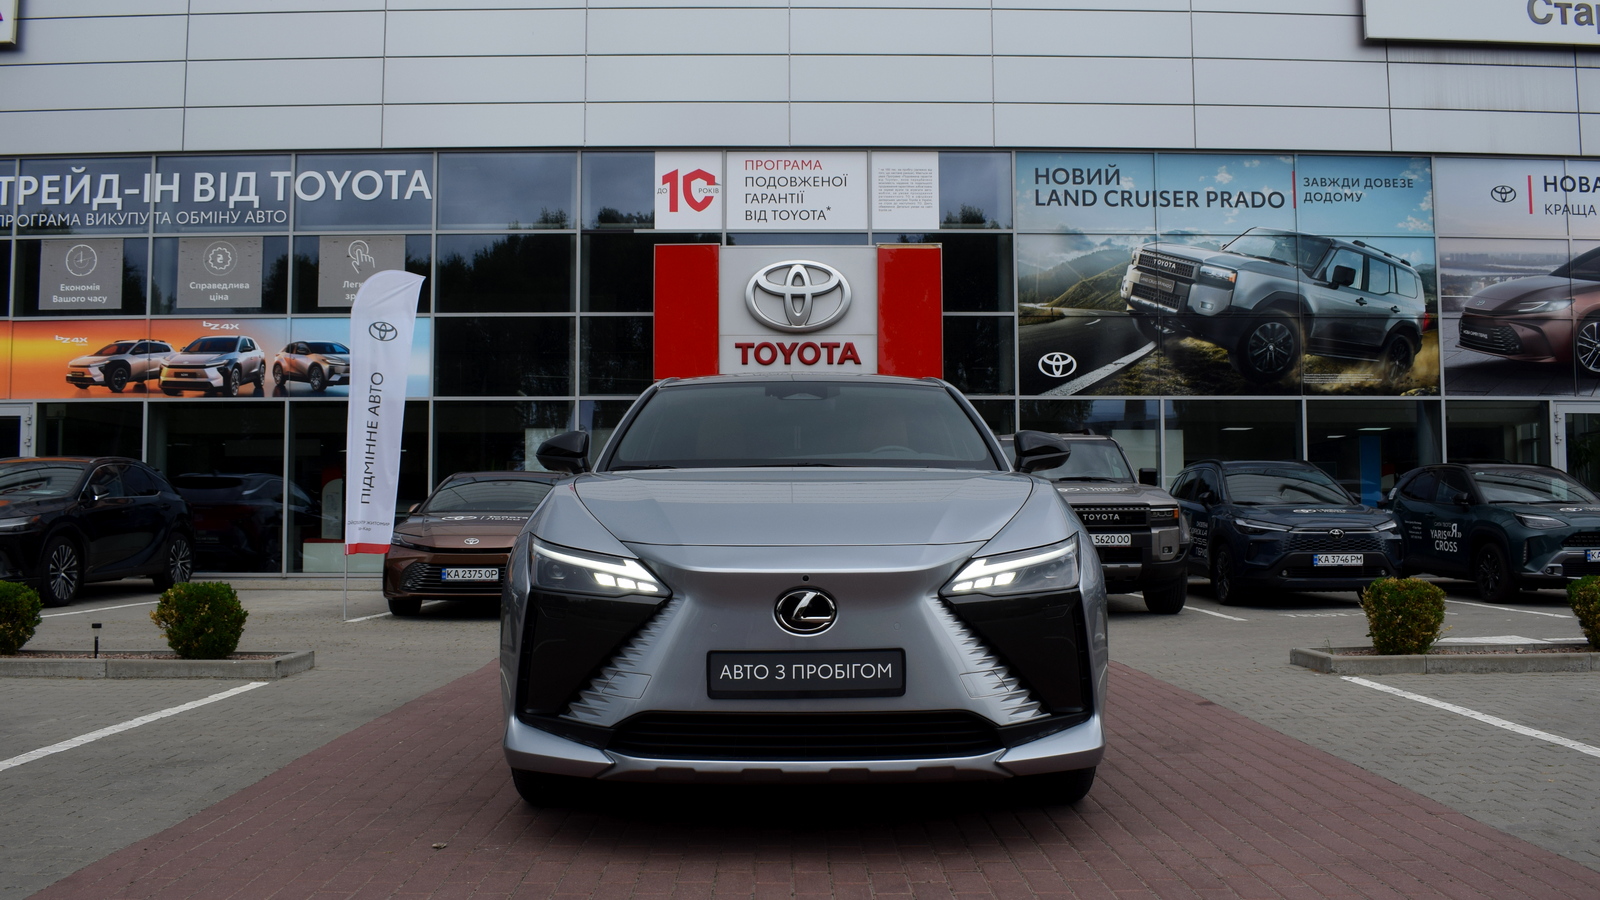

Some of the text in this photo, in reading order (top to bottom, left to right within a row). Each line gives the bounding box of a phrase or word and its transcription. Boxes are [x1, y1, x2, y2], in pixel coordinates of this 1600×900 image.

[1527, 0, 1600, 35] Ста
[744, 159, 823, 171] ПРОГРАМА
[744, 173, 848, 189] ПОДОВЖЕНОЇ
[1034, 163, 1121, 186] НОВИЙ
[0, 166, 433, 211] ТРЕЙД-ІН ВІД TOYOTA
[1303, 176, 1415, 191] ЗАВЖДИ ДОВЕЗЕ
[656, 187, 668, 195] ДО
[744, 190, 805, 204] ГАРАНТІЇ
[1303, 190, 1363, 204] ДОДОМУ
[1034, 189, 1285, 209] LAND CRUISER PRADO
[744, 210, 768, 223] ВІД
[1544, 203, 1597, 218] КРАЩА
[86, 212, 150, 227] ВИКУПУ
[154, 211, 172, 225] ТА
[176, 210, 241, 225] ОБМІНУ
[244, 209, 287, 224] АВТО
[60, 283, 101, 292] Економія
[189, 281, 250, 291] Справедлива
[52, 294, 107, 304] Вашого часу
[209, 292, 229, 302] ціна
[735, 342, 861, 365] TOYOTA
[360, 372, 384, 505] ПІДМІННЕ АВТО
[1082, 513, 1120, 521] TOYOTA
[1095, 535, 1116, 544] 5620
[1430, 529, 1447, 540] YARIS
[1434, 540, 1458, 553] CROSS
[1331, 555, 1350, 564] 3746
[461, 569, 483, 579] 2375
[719, 664, 769, 680] АВТО
[792, 663, 893, 679] ПРОБІГОМ
